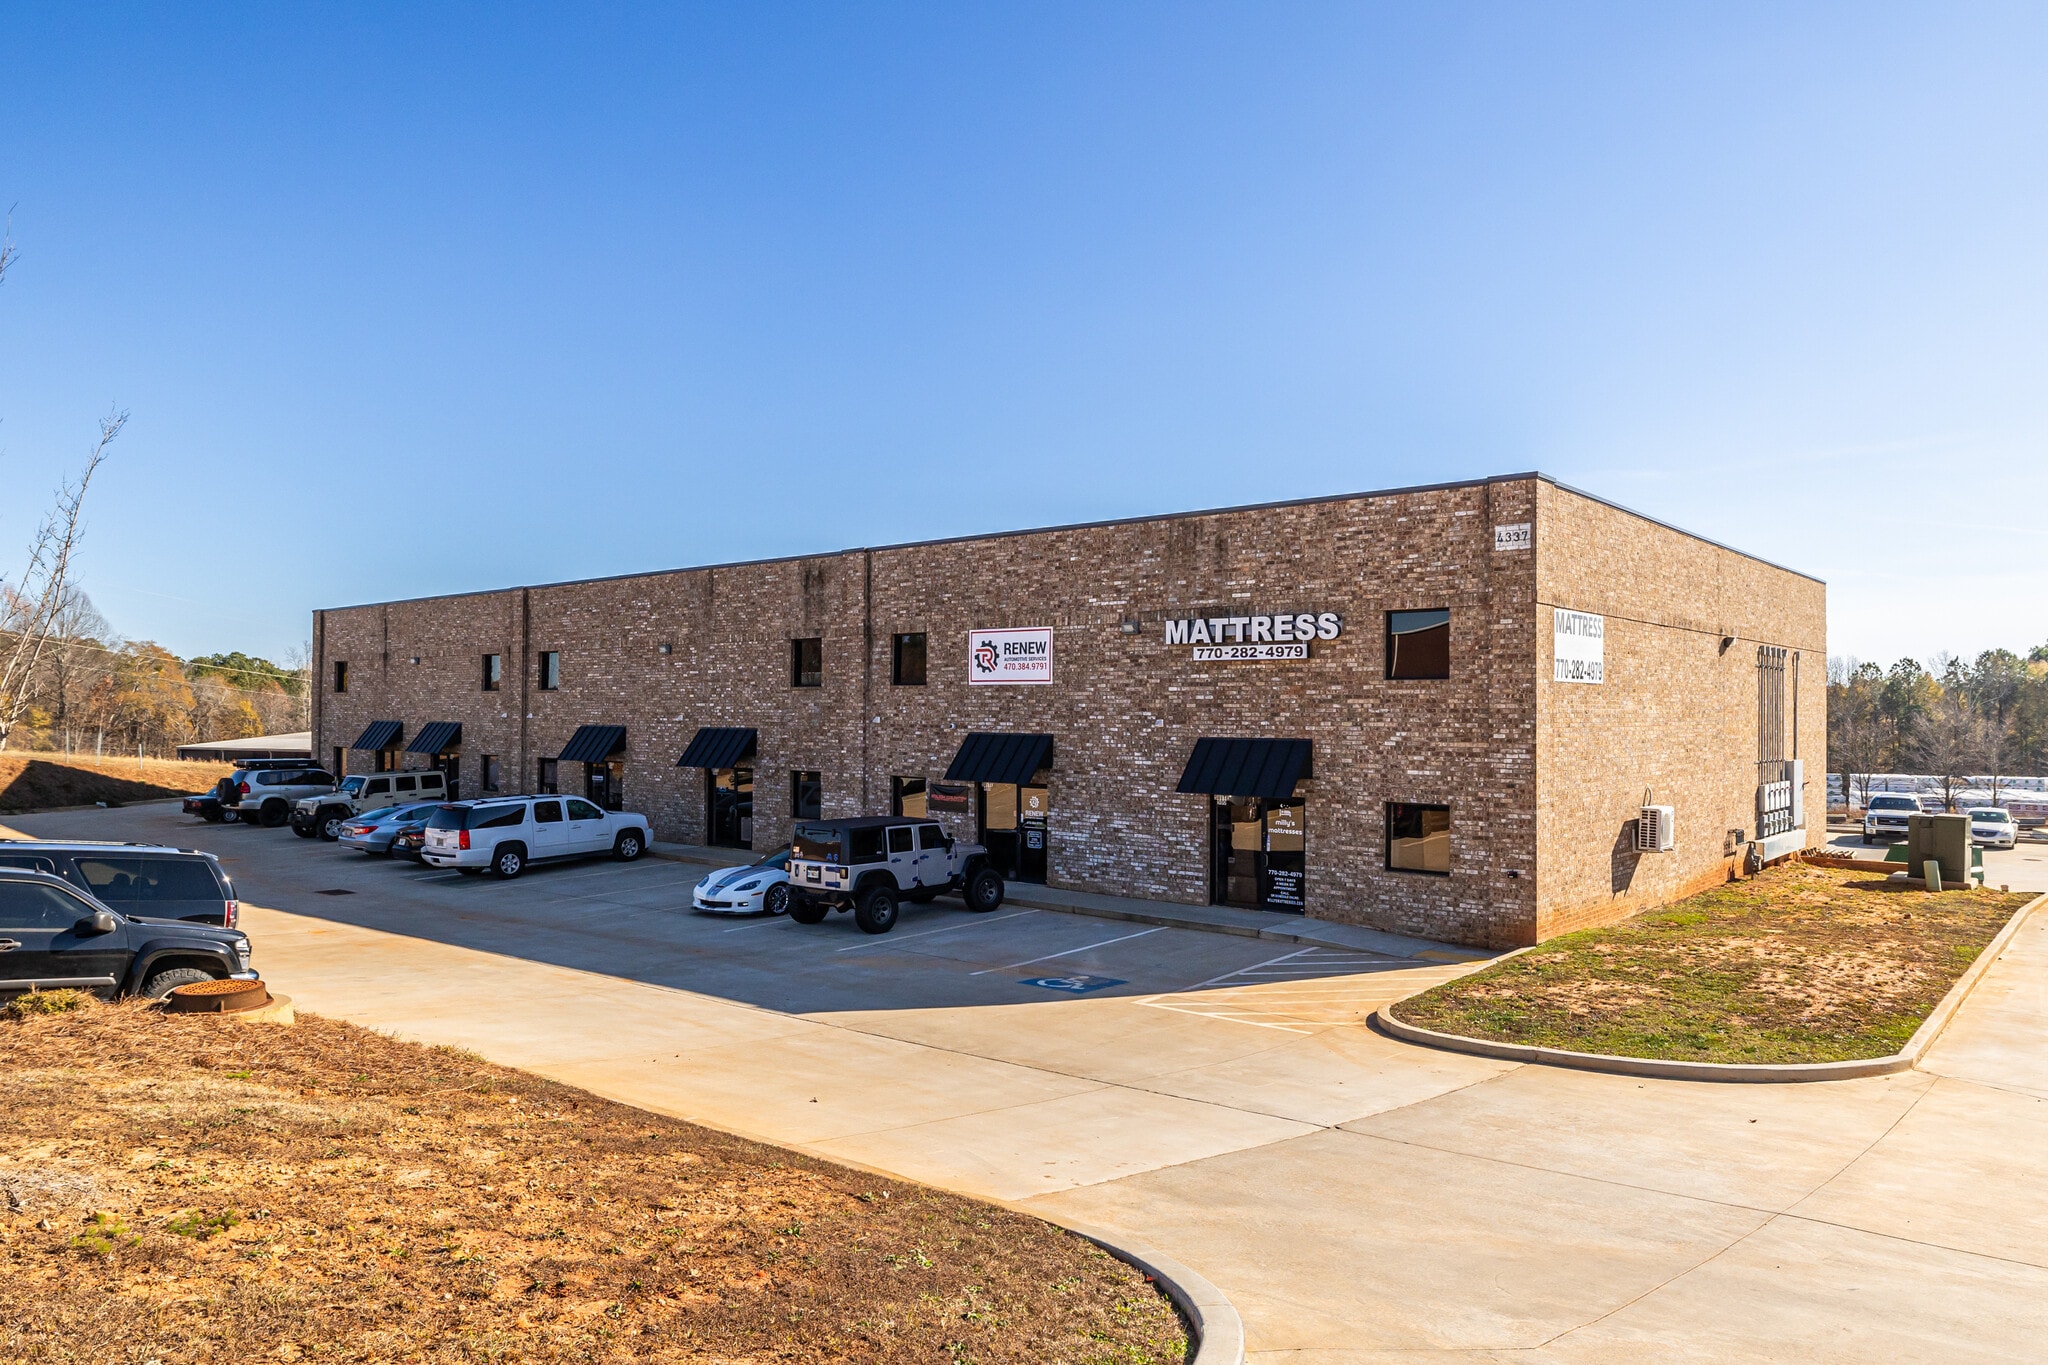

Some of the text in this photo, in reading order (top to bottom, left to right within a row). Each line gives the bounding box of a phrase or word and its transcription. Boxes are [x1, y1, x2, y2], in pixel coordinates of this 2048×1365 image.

[1496, 531, 1528, 543] 4337
[1165, 612, 1340, 645] MATTRESS
[1555, 611, 1602, 639] MATTRESS
[1004, 641, 1047, 655] RENEW
[1196, 645, 1304, 659] 770-282-4979
[1004, 662, 1047, 671] 470.384.9791
[1555, 658, 1602, 681] 770-282-4979
